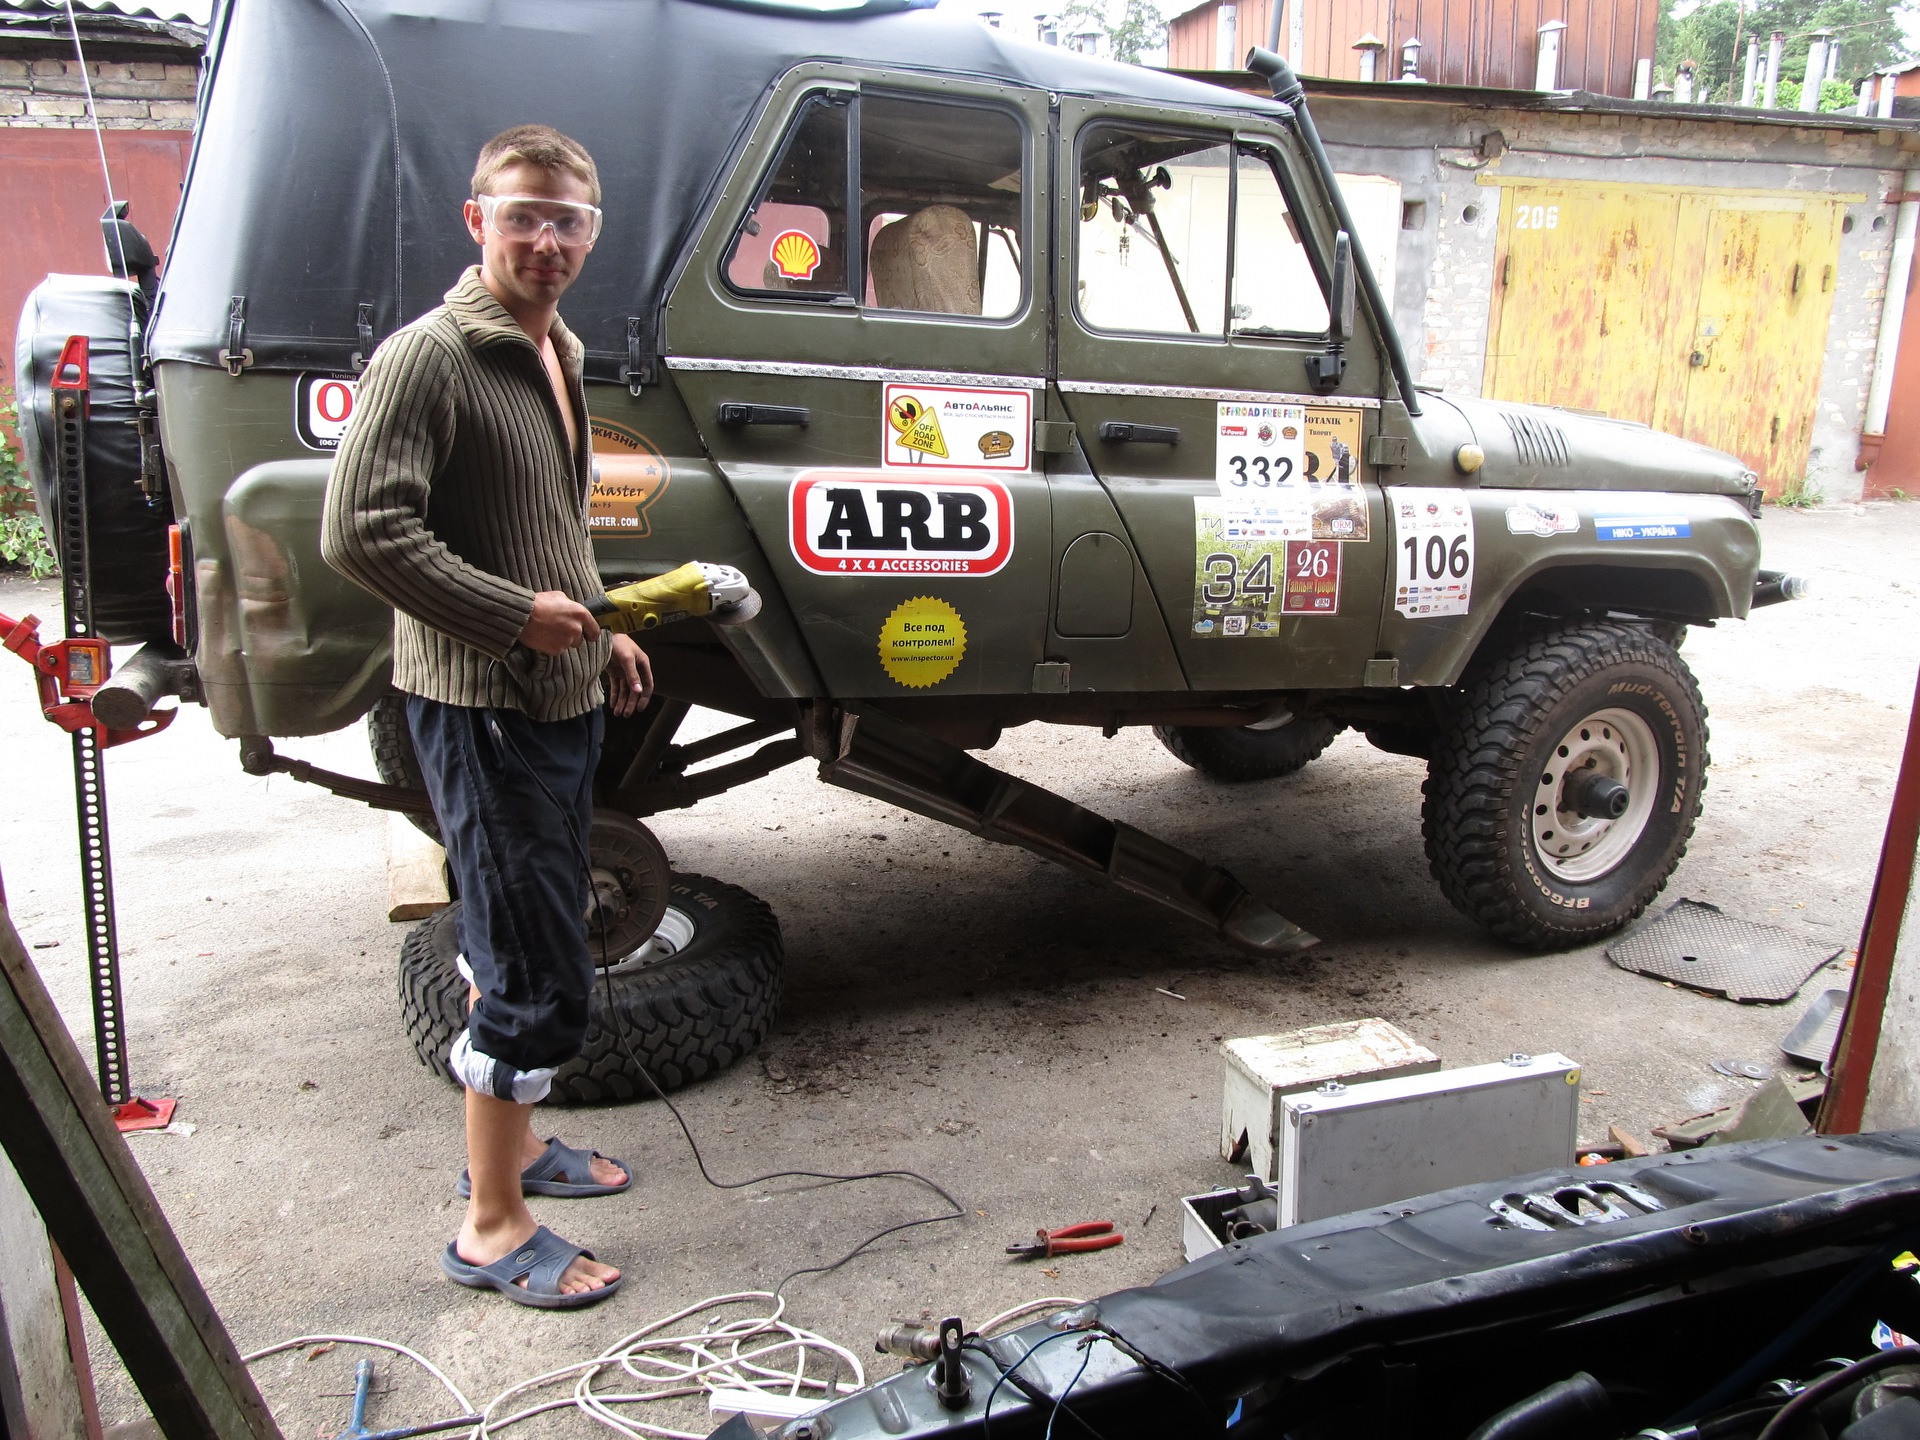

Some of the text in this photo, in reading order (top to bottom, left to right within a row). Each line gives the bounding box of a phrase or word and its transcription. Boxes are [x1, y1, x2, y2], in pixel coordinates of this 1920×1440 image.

[1515, 205, 1560, 230] 206
[331, 372, 357, 380] Tuning
[317, 382, 357, 422] O
[1219, 405, 1302, 419] OFFROAD FREE FEST
[919, 423, 934, 433] OFF
[1221, 428, 1246, 436] V-Power
[1309, 428, 1332, 437] TROPHY
[913, 430, 936, 441] ROAD
[913, 437, 934, 450] ZONE
[1229, 455, 1294, 488] 332
[591, 484, 644, 498] Master
[589, 517, 639, 527] ASTER.COM
[817, 487, 991, 552] ARB
[1333, 520, 1352, 529] ORM
[1642, 525, 1677, 537] УКРАЇНА
[1297, 548, 1329, 577] 26
[1404, 534, 1469, 580] 106
[837, 559, 969, 572] 4 X 4 ACCESSORIES
[1202, 552, 1276, 605] 34
[903, 622, 945, 634] Все под
[891, 636, 955, 649] контролем!
[890, 653, 954, 663] www.inspector.ua
[1670, 776, 1686, 814] T/A
[693, 891, 720, 910] T/A
